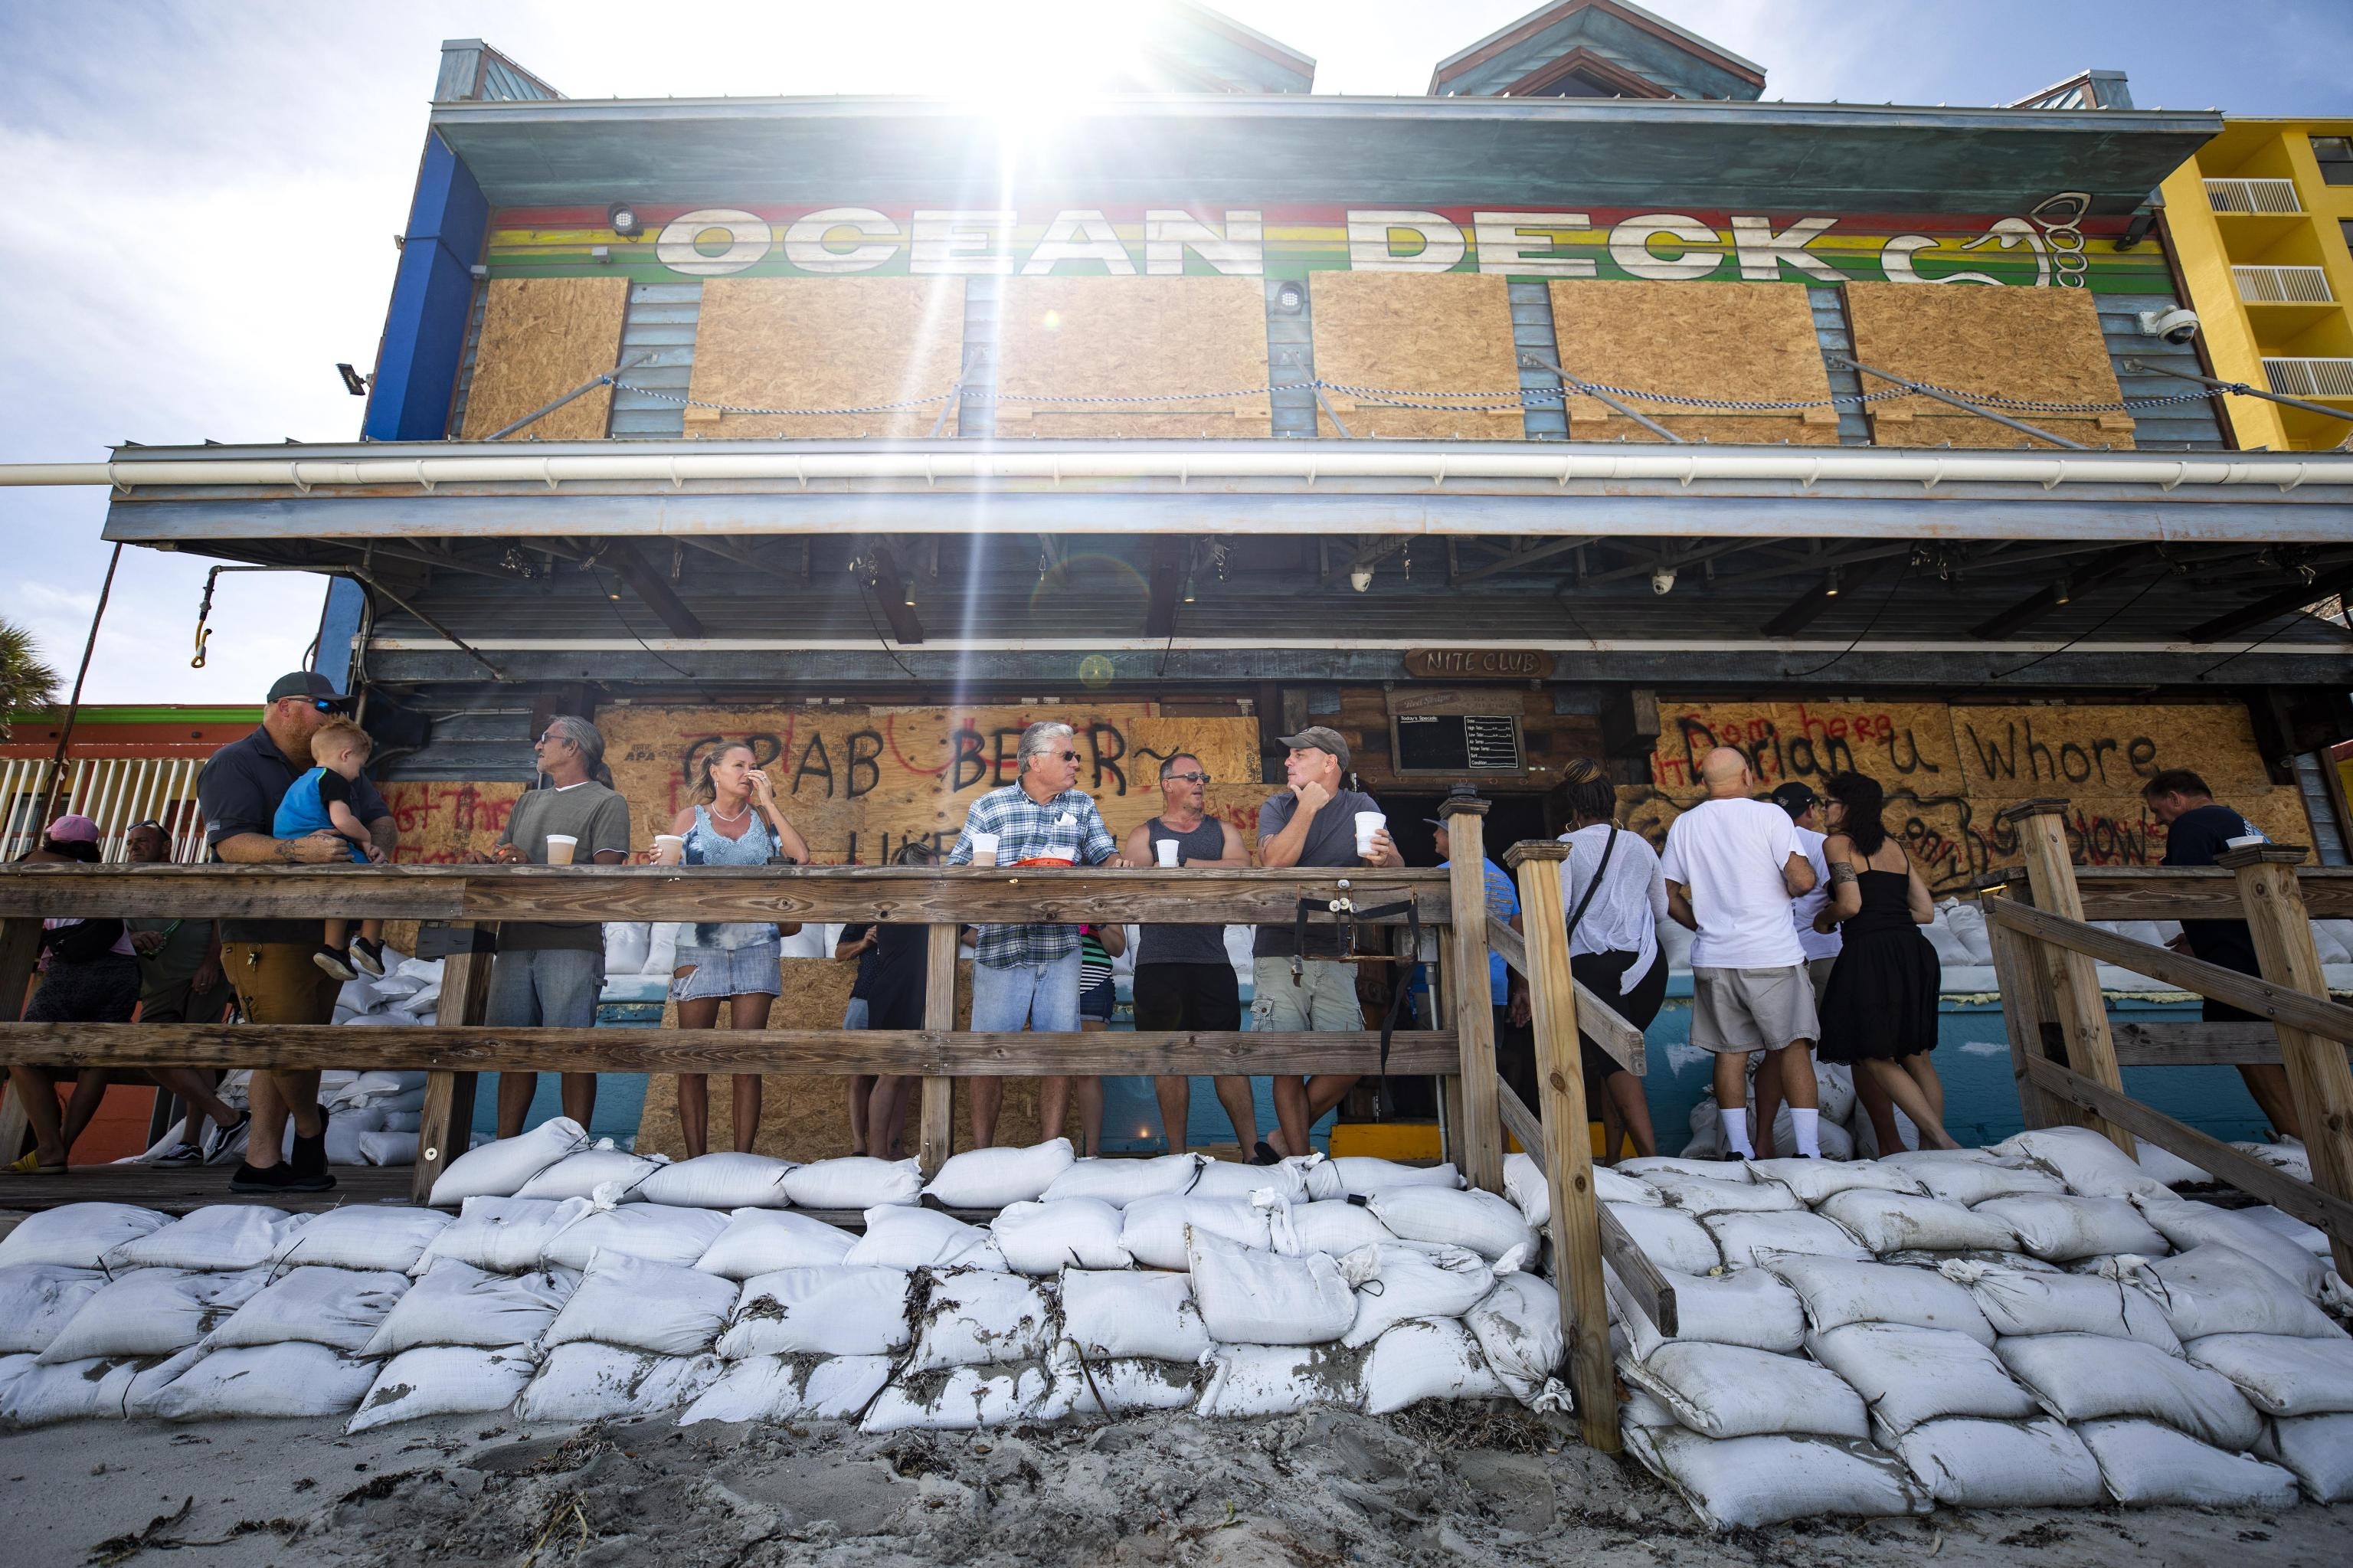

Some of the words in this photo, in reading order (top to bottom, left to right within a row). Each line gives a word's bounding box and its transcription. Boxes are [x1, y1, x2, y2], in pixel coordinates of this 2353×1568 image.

[656, 207, 1264, 277] OCEAN
[1347, 209, 1854, 283] DECK
[1427, 651, 1475, 672] NITE
[1483, 653, 1536, 673] CLUB
[953, 722, 1127, 797] BER
[1965, 717, 2159, 784] Whore
